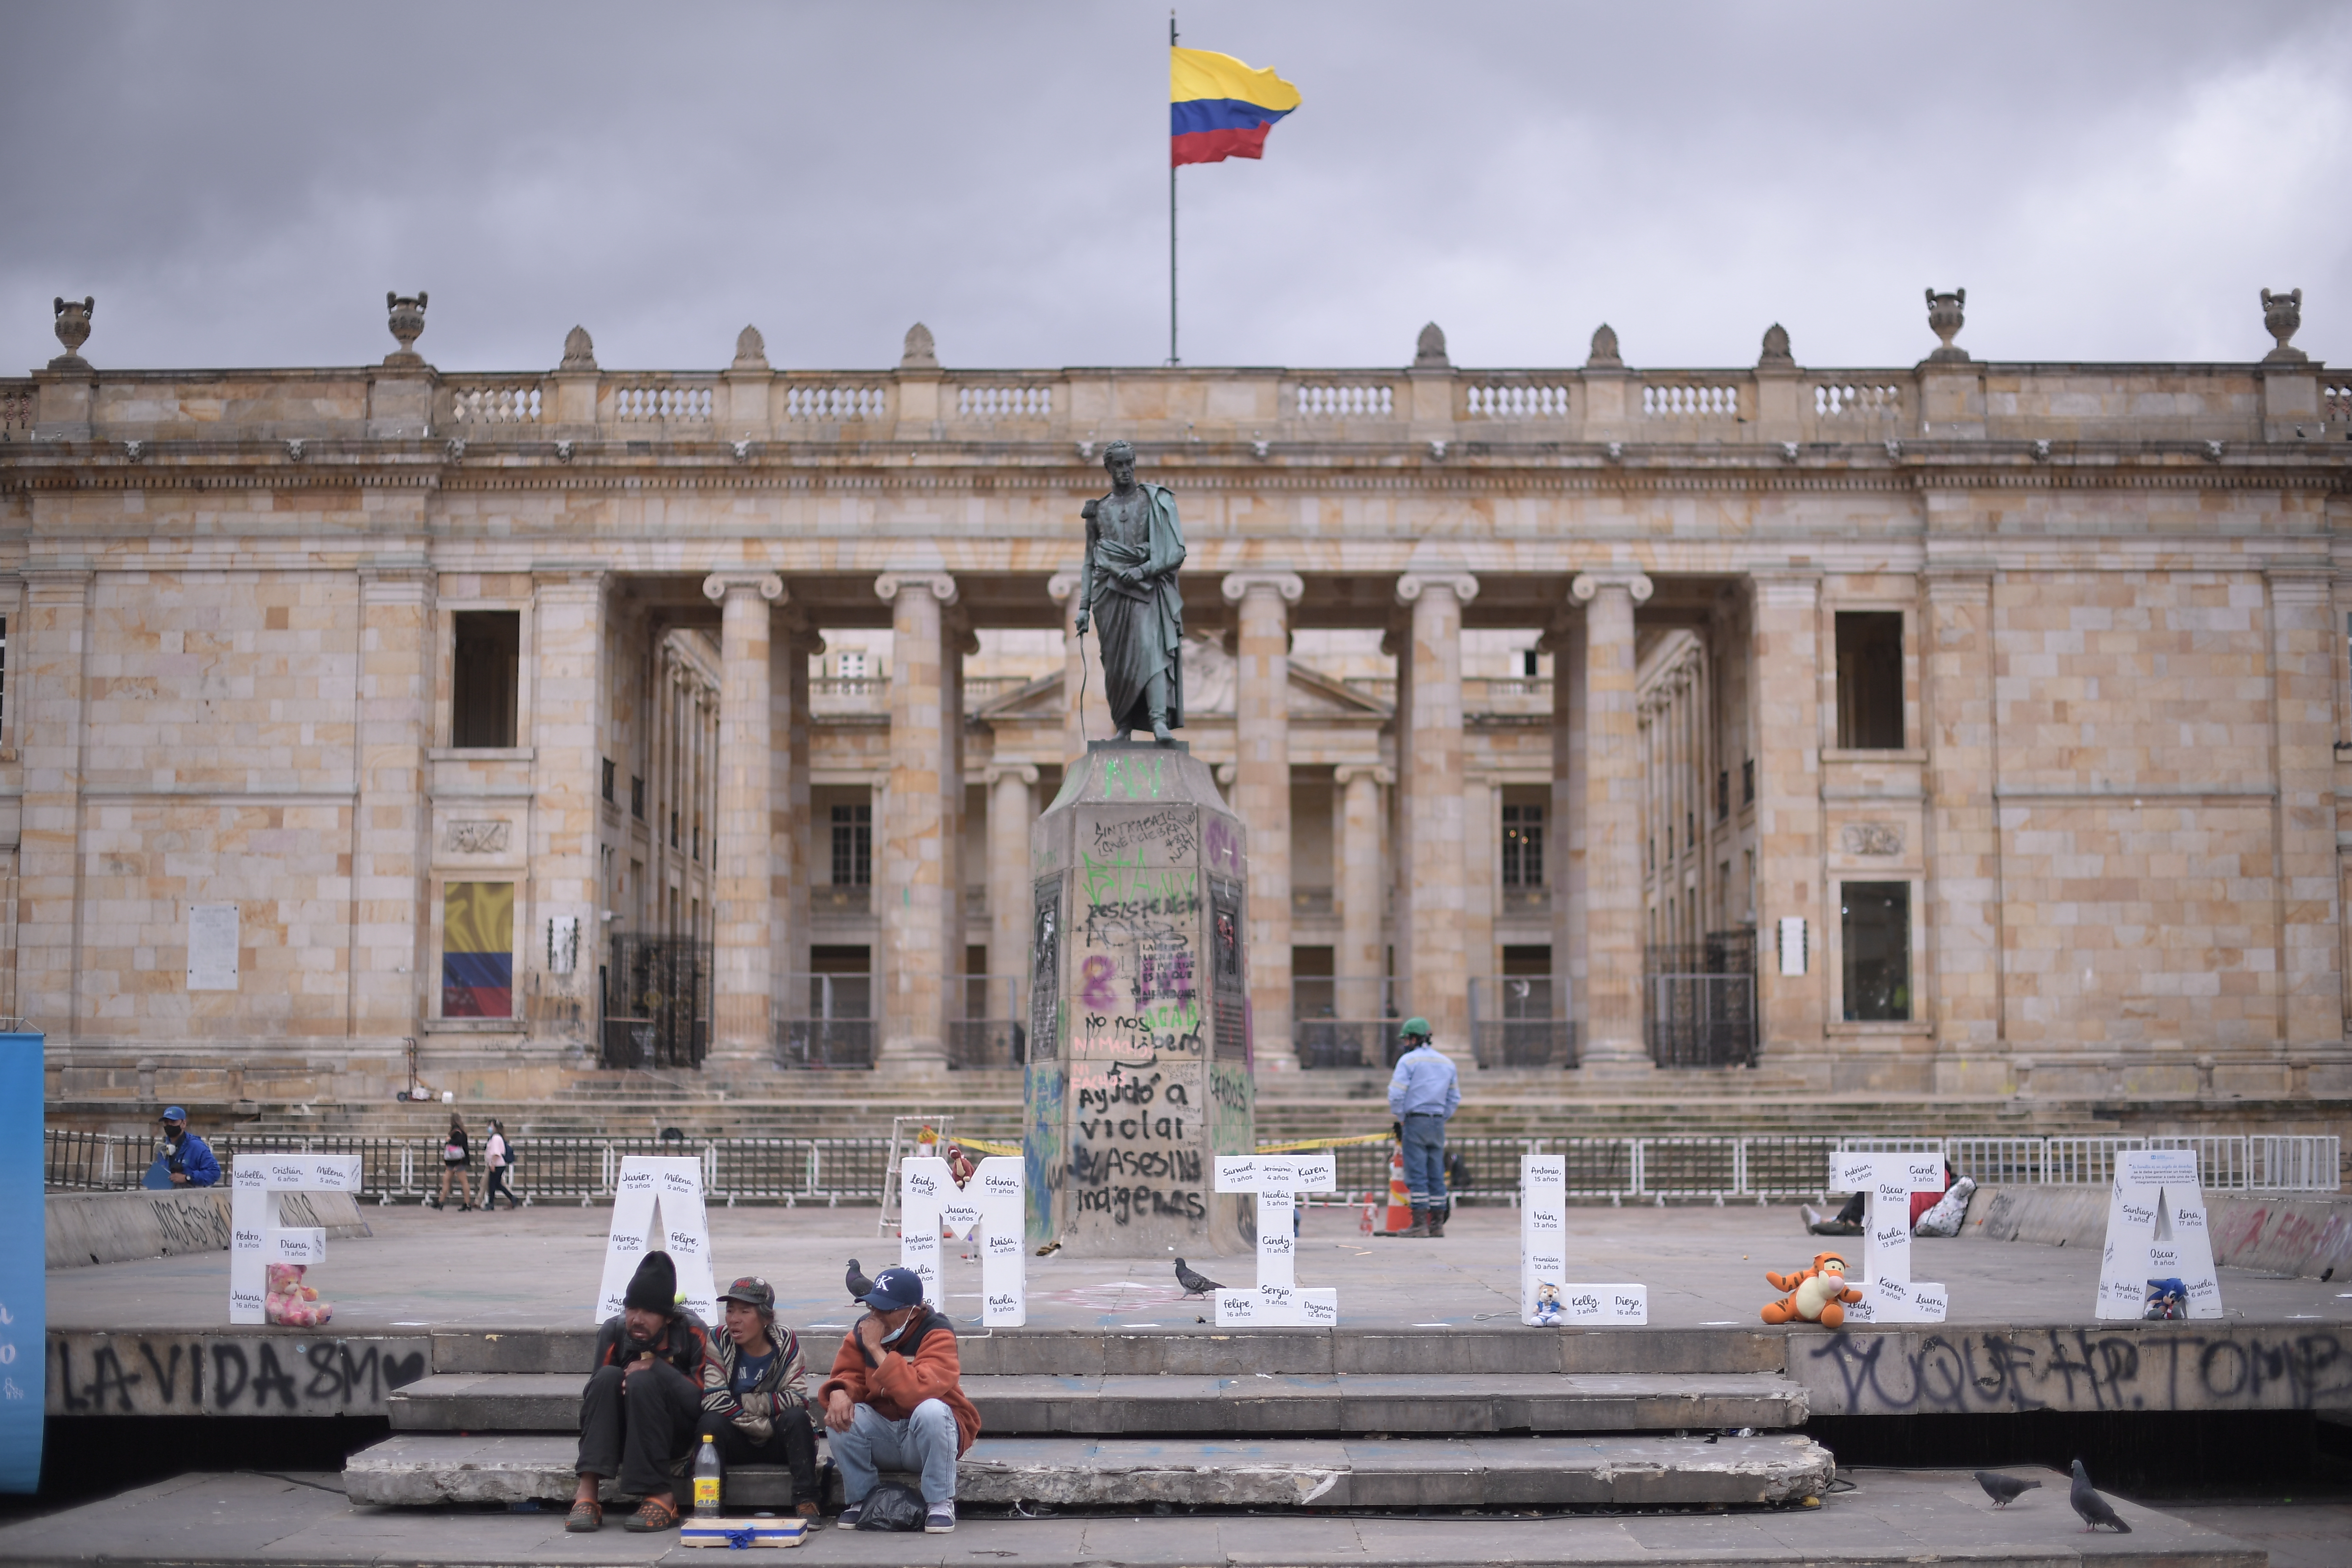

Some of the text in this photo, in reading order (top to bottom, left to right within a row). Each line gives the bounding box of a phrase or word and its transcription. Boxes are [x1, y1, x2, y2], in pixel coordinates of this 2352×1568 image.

[1145, 1004, 1197, 1030] ACAB
[1073, 1064, 1089, 1076] NI
[1165, 1083, 1189, 1105] a
[272, 1166, 303, 1176] Cristián,
[316, 1166, 346, 1179] Milena,
[1223, 1162, 1256, 1176] Samuel,
[1263, 1165, 1293, 1173] Jerónimo,
[1298, 1166, 1328, 1177] Karen,
[1530, 1166, 1562, 1175] Antonio,
[1909, 1164, 1937, 1176] Carol,
[234, 1171, 266, 1181] Isabella,
[622, 1172, 654, 1182] Javier,
[664, 1173, 694, 1187] Milena,
[1858, 1171, 1872, 1181] años
[910, 1173, 937, 1191] Leidy,
[985, 1176, 1019, 1188] Edwin,
[917, 1188, 933, 1196] años
[1262, 1190, 1292, 1199] Nicolás,
[1880, 1184, 1907, 1195] Oscar,
[945, 1204, 977, 1215] Juana,
[2123, 1205, 2156, 1219] Santiago,
[2178, 1209, 2201, 1220] Lina,
[236, 1231, 261, 1242] Pedro,
[612, 1234, 642, 1244] Mireya,
[905, 1234, 936, 1244] Antonio,
[1878, 1227, 1906, 1241] Paula,
[280, 1239, 310, 1250] Diana,
[989, 1237, 1017, 1247] Luisa,
[1262, 1235, 1293, 1249] Cindy,
[1890, 1238, 1906, 1246] años
[2150, 1249, 2178, 1259] Oscar,
[1261, 1285, 1293, 1299] Sergio,
[1879, 1277, 1907, 1296] Karen,
[2115, 1282, 2142, 1294] Andrés,
[231, 1291, 263, 1302] Juana,
[989, 1294, 1017, 1305] Paola,
[1572, 1294, 1600, 1308] Kelly,
[1885, 1292, 1901, 1300] años
[1916, 1293, 1945, 1308] Laura,
[1304, 1301, 1336, 1313] Dayana,
[1615, 1296, 1642, 1309] Diego,
[58, 1340, 380, 1411] LA VIDA 8M
